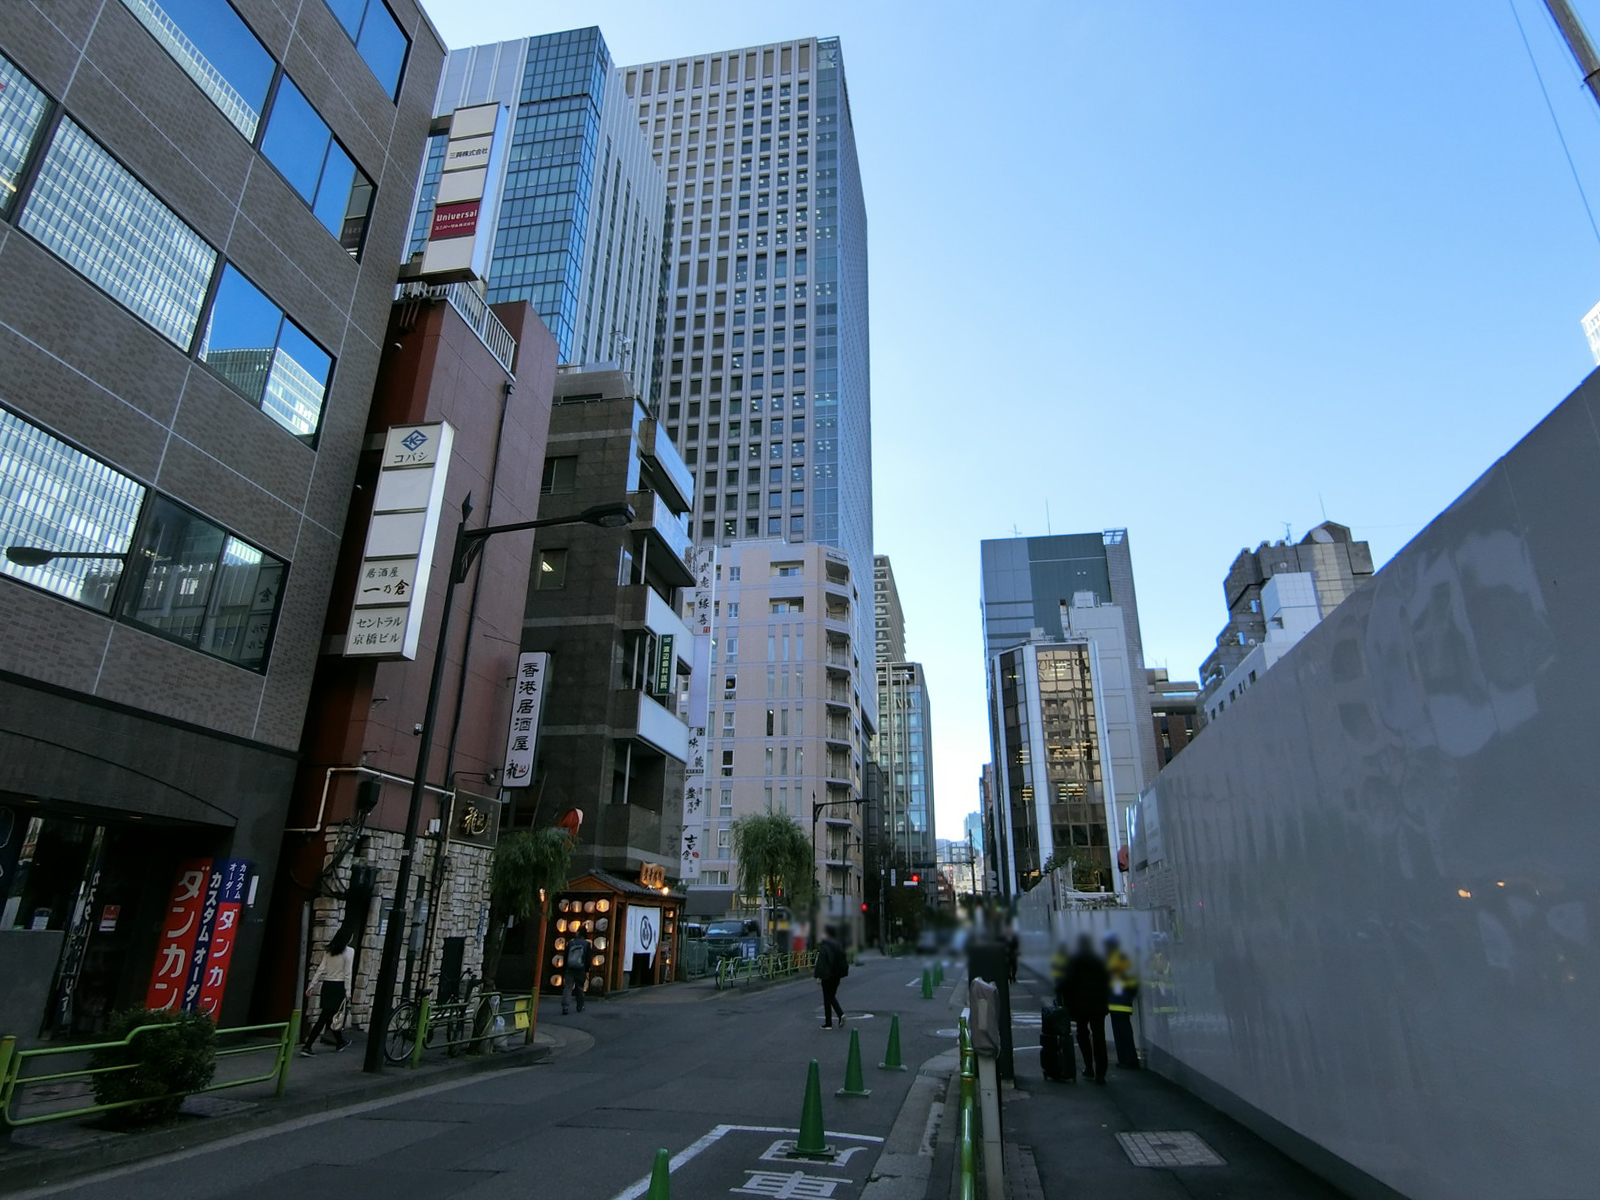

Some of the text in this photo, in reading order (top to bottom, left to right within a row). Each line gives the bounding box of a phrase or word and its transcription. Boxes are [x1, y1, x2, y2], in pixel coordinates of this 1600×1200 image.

[436, 209, 478, 222] Universal
[393, 451, 429, 464] コバシ
[366, 567, 399, 579] 居酒屋
[363, 579, 410, 596] 一乃倉
[356, 615, 403, 629] セントラル
[352, 632, 400, 646] 京橋ビル
[511, 662, 539, 751] 香港居酒屋
[225, 862, 238, 899] オーダー
[234, 863, 247, 900] カスタム
[150, 866, 210, 1012] ダンカン
[201, 909, 238, 1017] ダンカン
